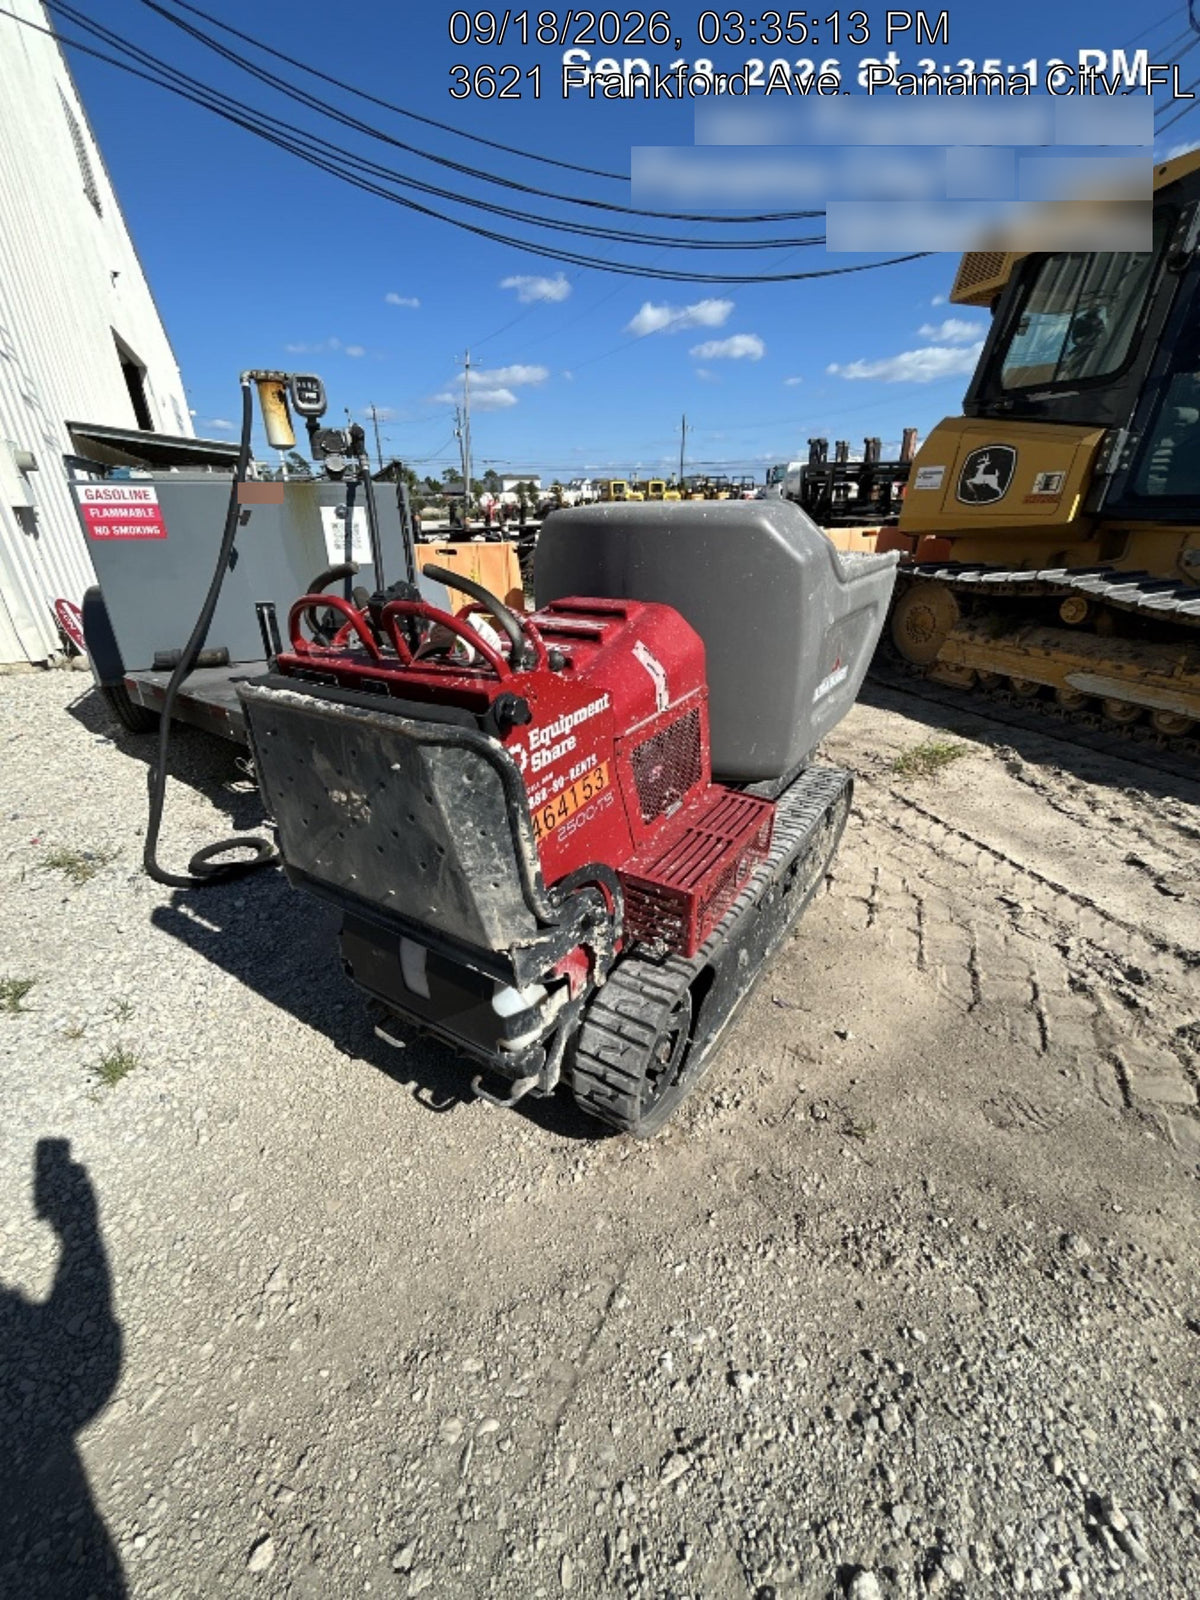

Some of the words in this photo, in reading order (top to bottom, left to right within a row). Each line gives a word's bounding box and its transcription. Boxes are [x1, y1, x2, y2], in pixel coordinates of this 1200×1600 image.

[84, 488, 152, 501] GASOLINE
[89, 507, 155, 518] FLAMMABLE
[93, 525, 110, 536] NO
[112, 525, 161, 536] SMOKING
[528, 692, 611, 751] Equipment
[531, 735, 577, 773] Share
